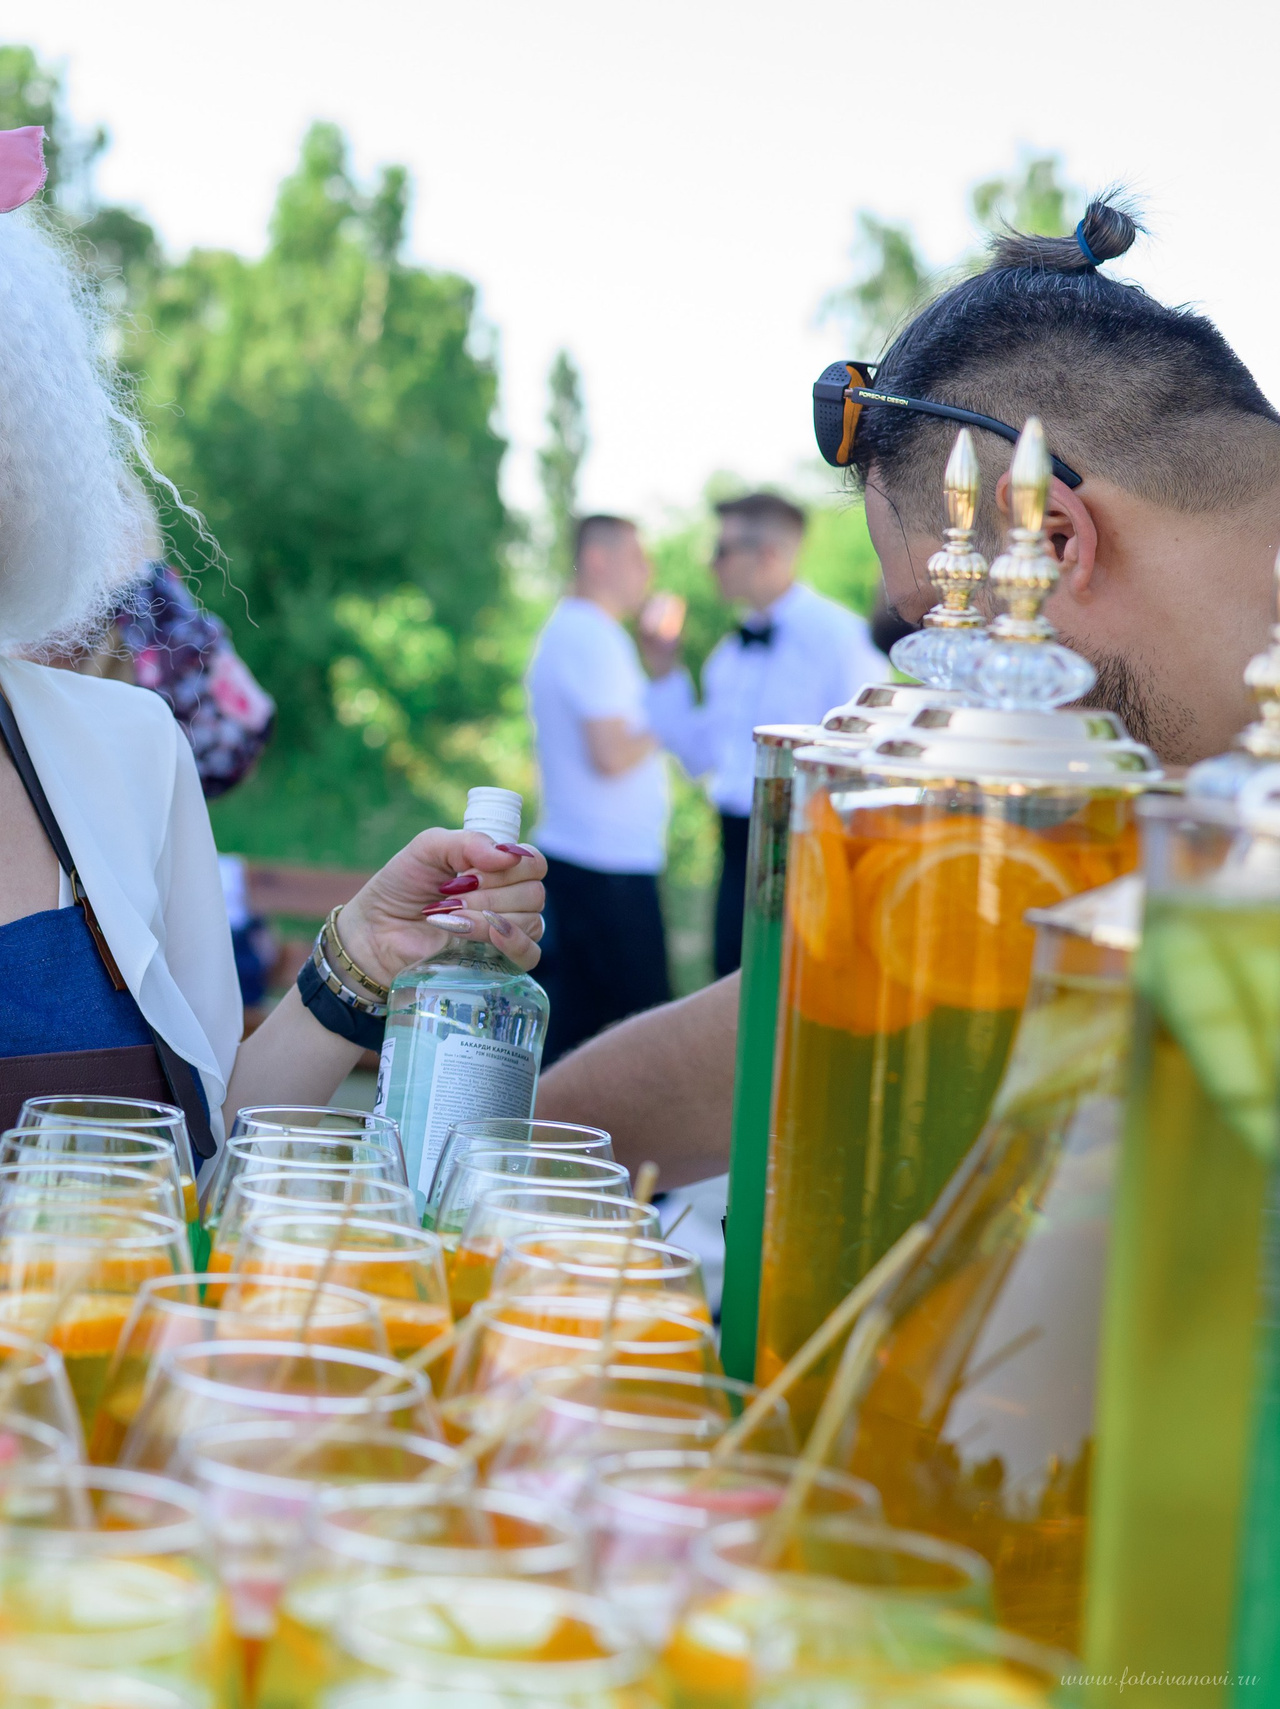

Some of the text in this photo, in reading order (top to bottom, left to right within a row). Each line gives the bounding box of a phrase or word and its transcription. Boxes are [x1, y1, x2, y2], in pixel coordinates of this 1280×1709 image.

[859, 391, 909, 406] PORSCHE DESIGN
[460, 1041, 529, 1062] БАКАРДИ КАРТА БЛАНКА
